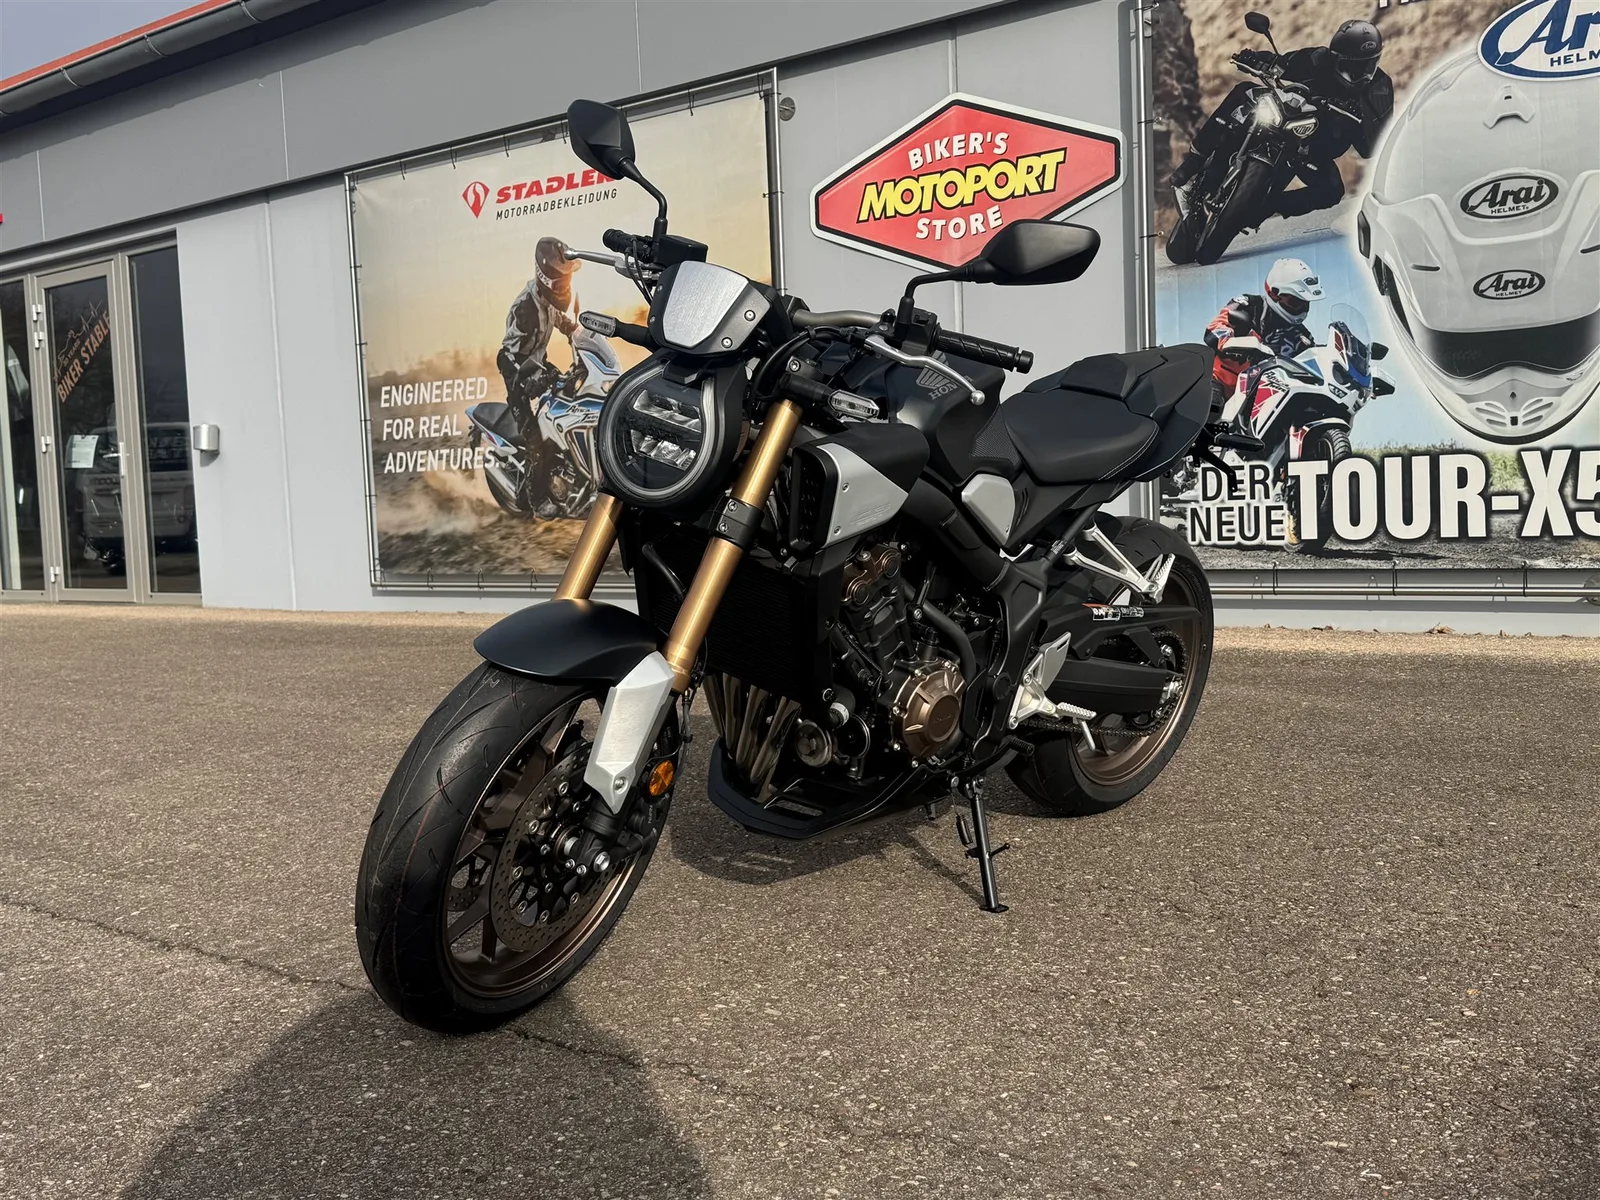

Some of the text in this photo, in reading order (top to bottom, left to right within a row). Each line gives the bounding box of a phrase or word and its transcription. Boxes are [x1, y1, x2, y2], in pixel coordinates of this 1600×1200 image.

[1495, 0, 1600, 65] Ar
[1550, 49, 1600, 67] HELM
[908, 132, 1010, 171] BIKER'S
[857, 147, 1067, 223] MOTOPORT
[1468, 179, 1546, 211] Arai
[496, 188, 618, 220] MOTORRADBEKLEIDUNG
[915, 205, 1003, 240] STORE
[1479, 271, 1537, 294] Arai
[57, 358, 84, 403] BIKER
[81, 310, 111, 365] STABLE
[380, 376, 488, 408] ENGINEERED
[382, 413, 462, 441] FOR REAL
[384, 446, 500, 474] ADVENTURES.
[1201, 464, 1270, 501] DER
[1190, 505, 1285, 541] NEUE
